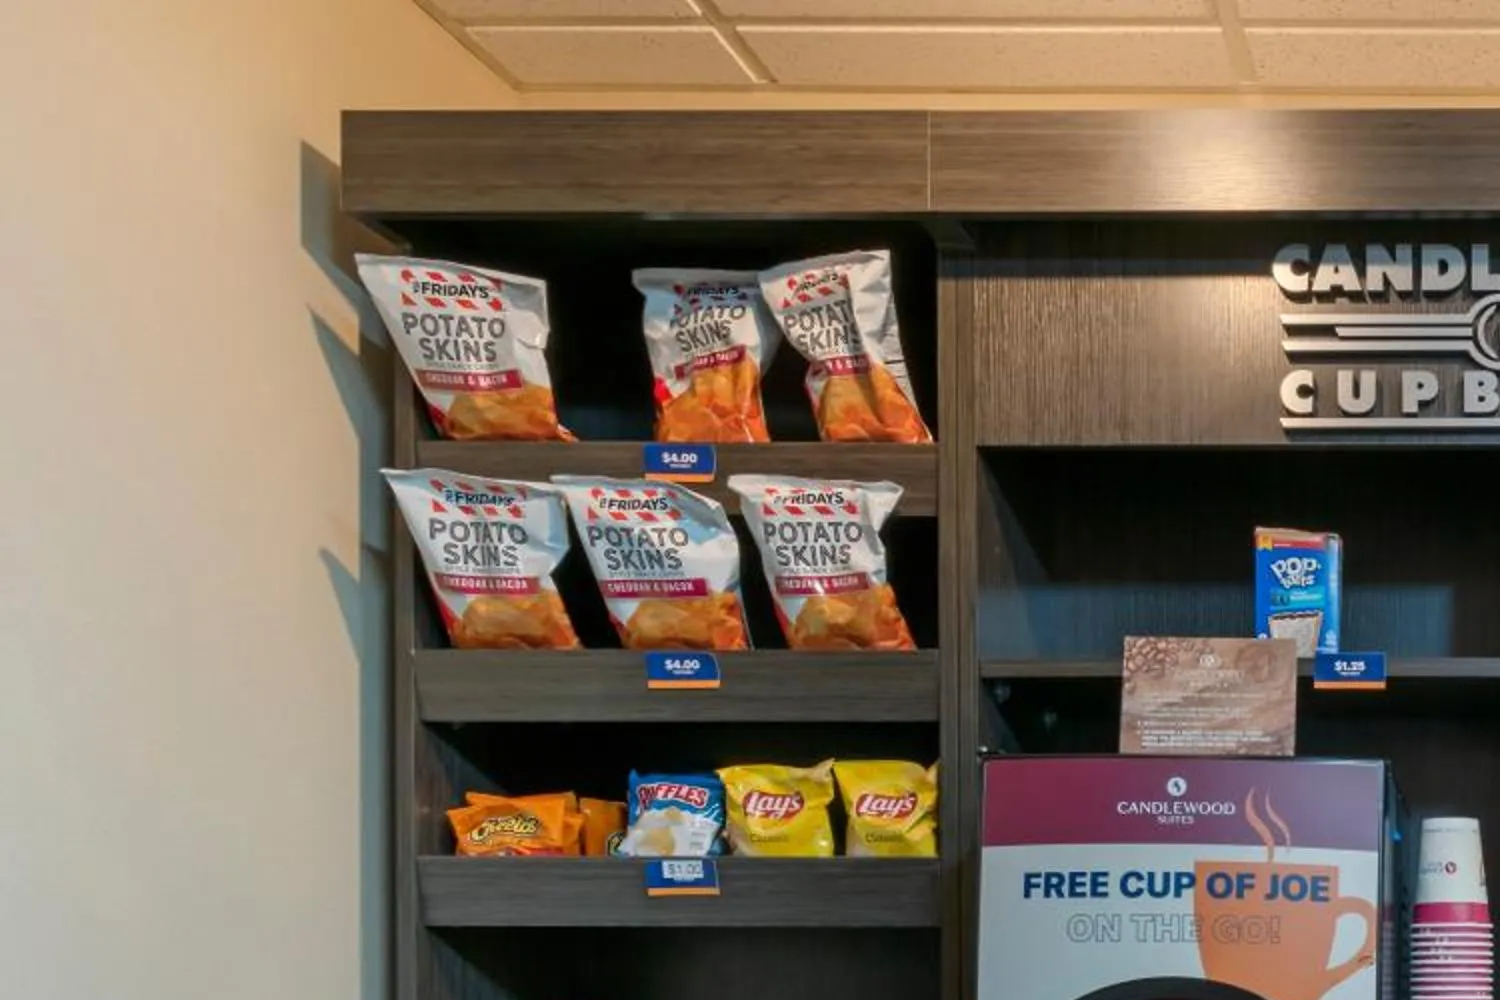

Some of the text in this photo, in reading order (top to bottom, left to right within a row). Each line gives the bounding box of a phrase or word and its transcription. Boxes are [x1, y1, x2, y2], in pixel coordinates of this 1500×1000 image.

[401, 311, 506, 339] POTATO
[675, 318, 731, 353] SKINS
[418, 337, 498, 363] SKINS
[661, 451, 698, 464] $4.00
[428, 518, 530, 545] POTATO
[587, 526, 690, 549] POTATO
[763, 521, 864, 544] POTATO
[442, 543, 521, 567] SKINS
[603, 548, 684, 572] SKINS
[774, 543, 853, 567] SKINS
[664, 659, 701, 672] $4.00
[637, 781, 710, 815] RUFFLES
[744, 790, 802, 820] Lay's
[858, 790, 917, 820] Lay's
[1116, 800, 1236, 816] CANDLEWOOD
[1023, 871, 1332, 903] FREE CUP OF JOE
[1066, 913, 1282, 945] ON THE GO!
